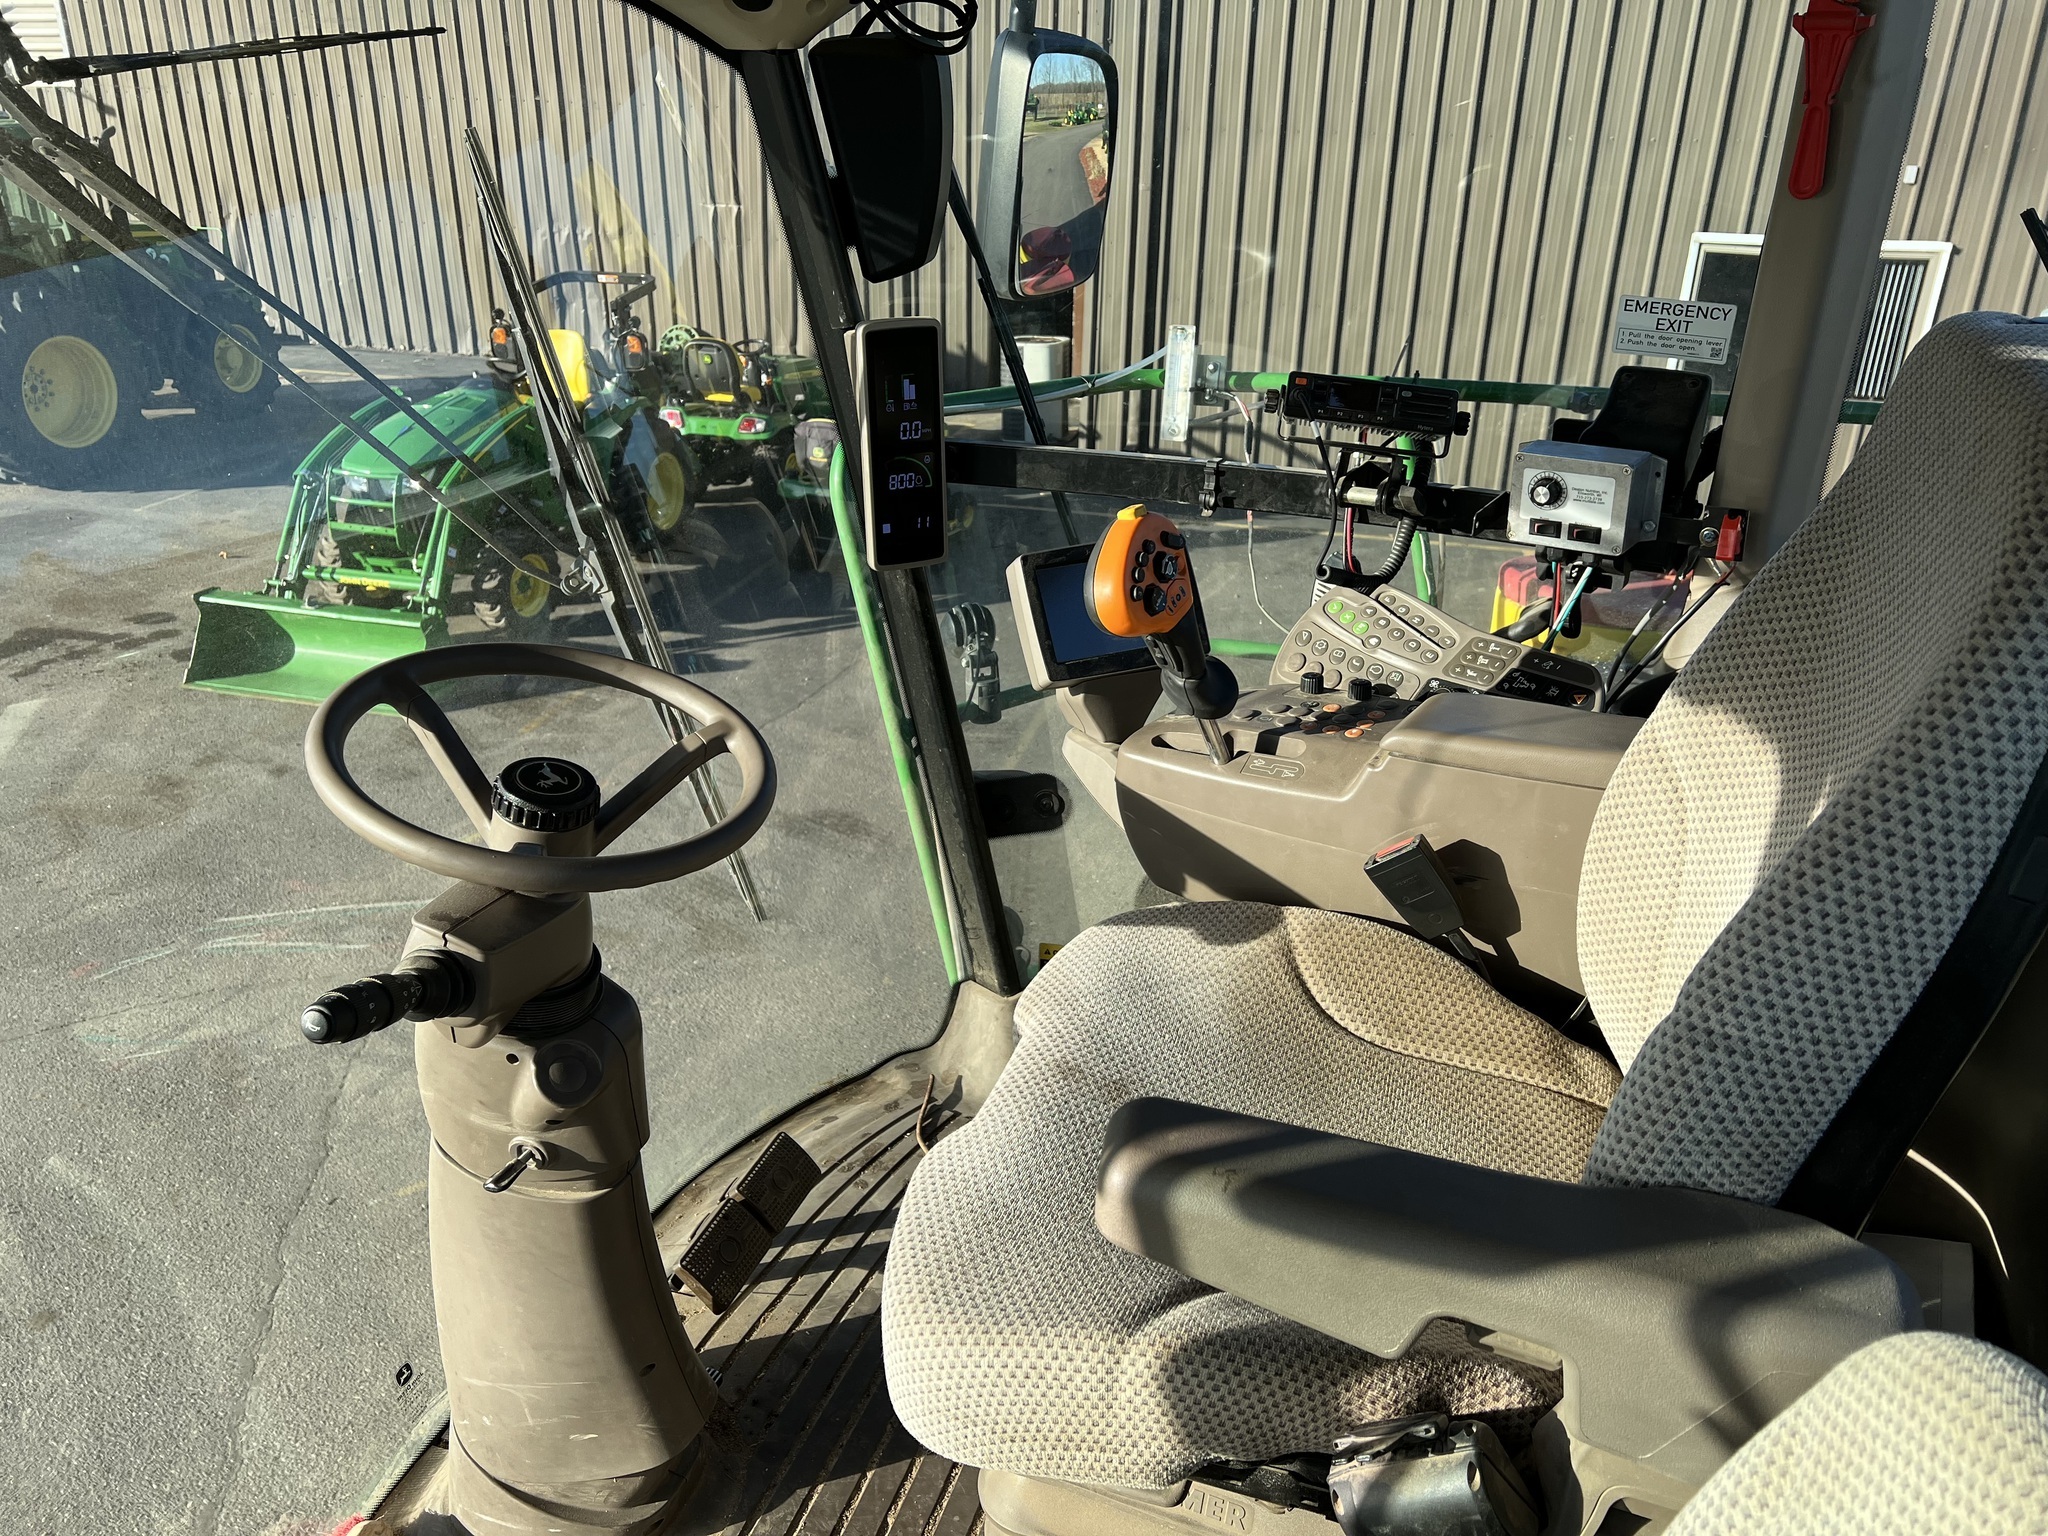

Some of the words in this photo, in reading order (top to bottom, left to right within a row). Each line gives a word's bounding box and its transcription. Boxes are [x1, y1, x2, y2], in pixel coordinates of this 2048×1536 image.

[1624, 299, 1732, 320] EMERGENCY
[1656, 318, 1693, 333] EXIT
[1676, 338, 1702, 346] opening
[900, 421, 921, 440] 0.0
[889, 473, 915, 490] 800
